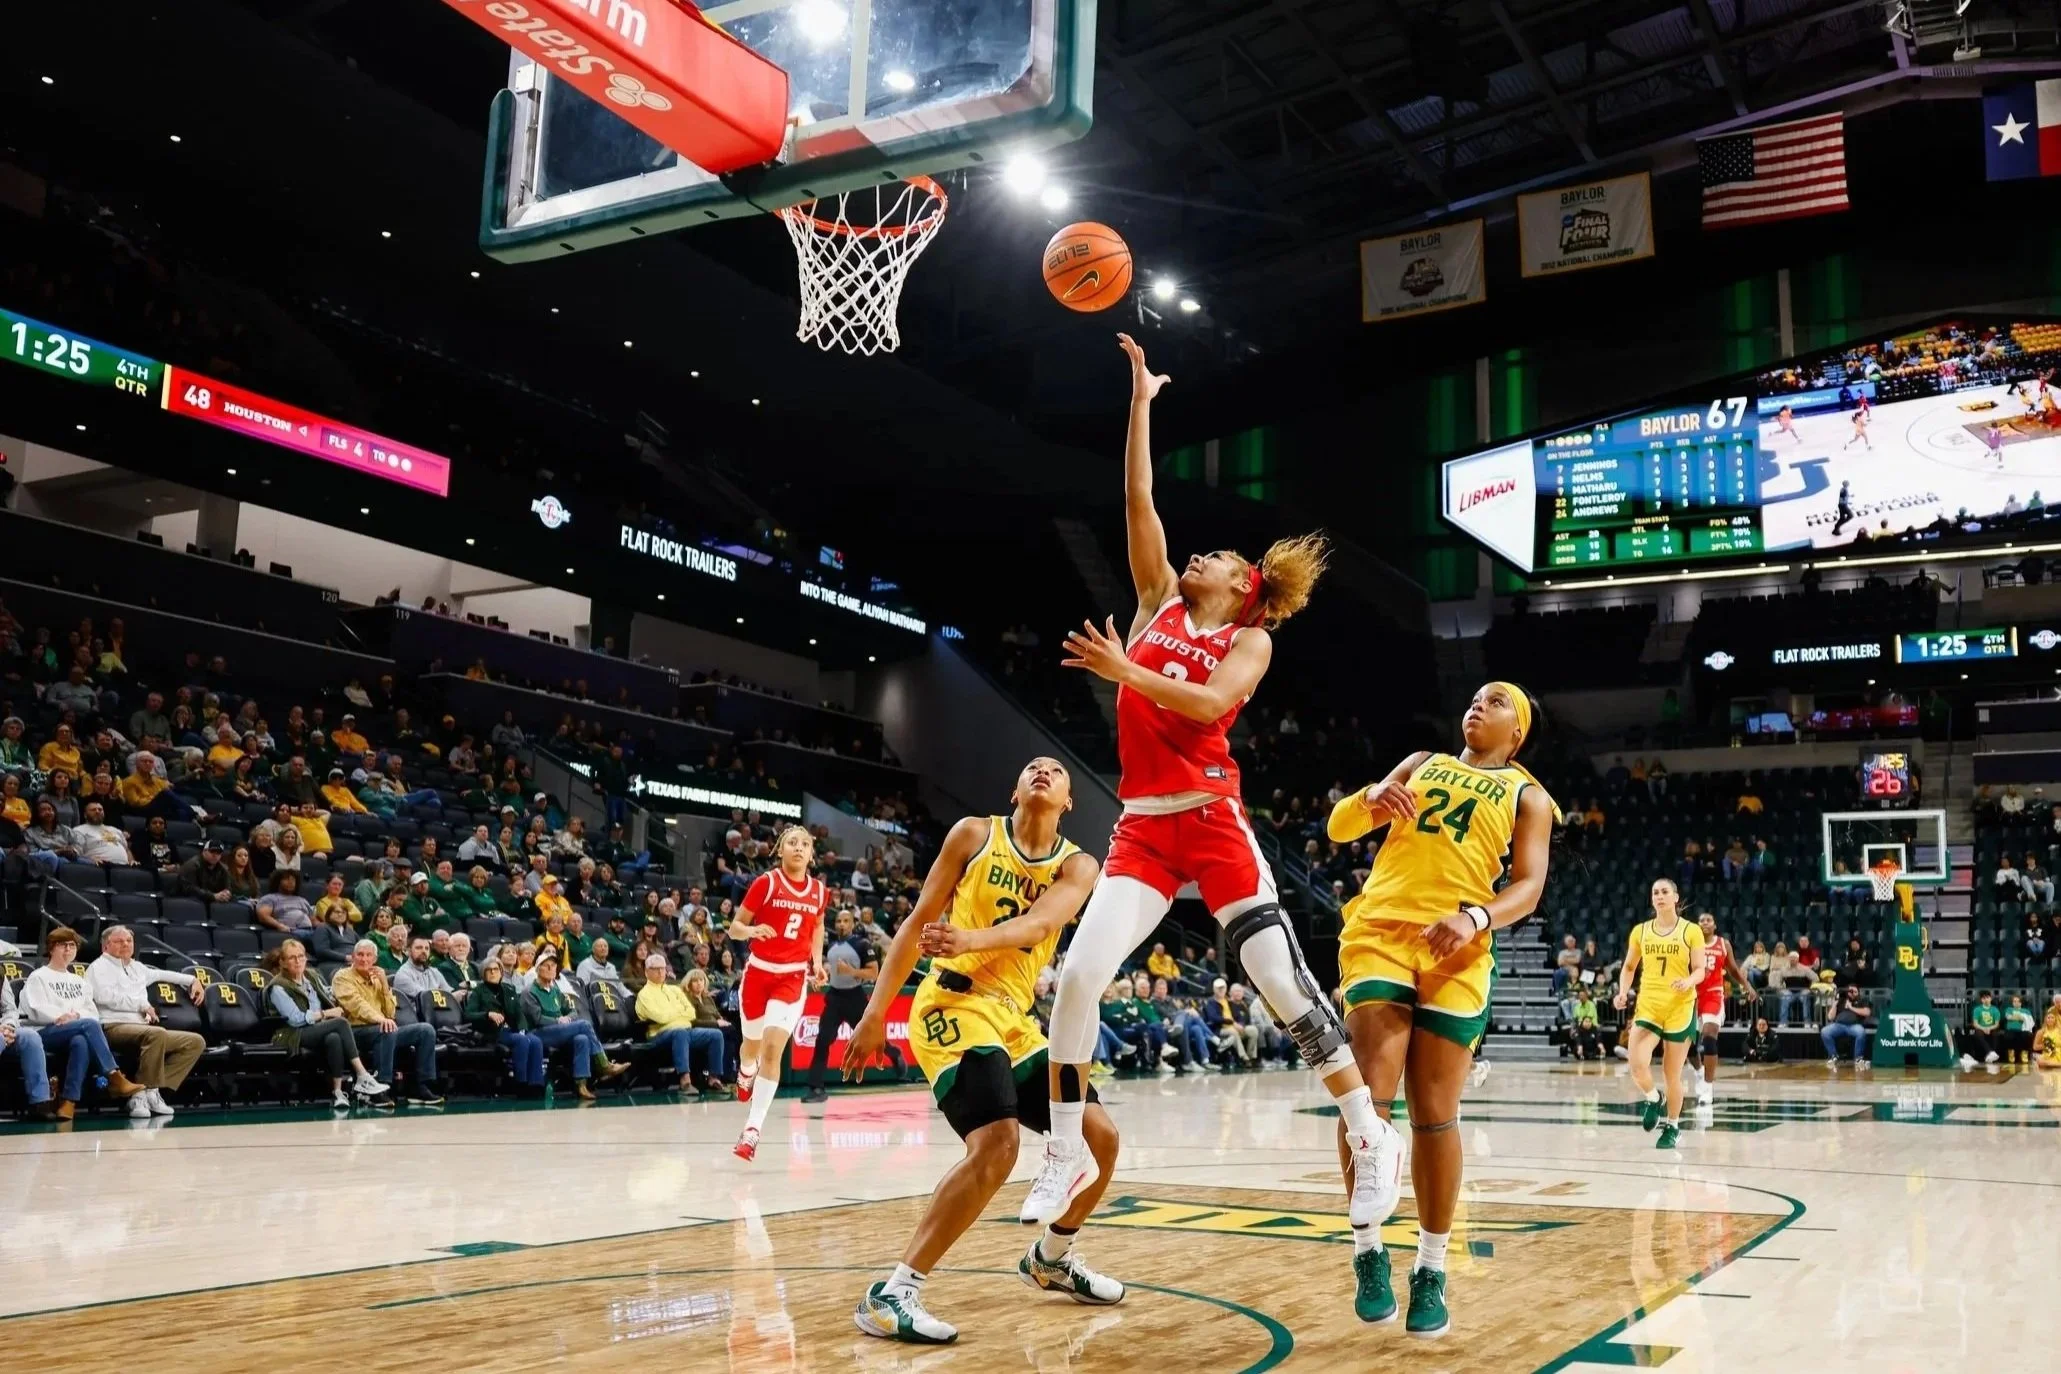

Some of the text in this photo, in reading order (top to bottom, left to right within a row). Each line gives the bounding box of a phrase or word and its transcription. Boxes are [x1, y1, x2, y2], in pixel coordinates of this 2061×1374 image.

[486, 2, 614, 75] State
[1561, 186, 1605, 204] BAYLOR
[1574, 216, 1608, 228] FINAL
[1400, 232, 1441, 251] BAYLOR
[1562, 225, 1608, 246] FOUR
[11, 321, 91, 375] 1:25
[116, 358, 149, 380] 4TH
[115, 376, 148, 397] QTR
[184, 389, 291, 432] 48 HOUSTON
[1707, 396, 1748, 429] 67
[1641, 412, 1700, 437] BAYLOR
[328, 434, 348, 451] FLS
[1703, 435, 1717, 443] AST
[372, 448, 387, 463] TO
[1572, 459, 1618, 472] JENNINGS
[1459, 478, 1517, 513] LIBMAN
[1572, 482, 1618, 494] MATHARU
[1572, 492, 1627, 506] FONTLEROY
[1572, 504, 1619, 517] ANDREWS
[1555, 532, 1570, 541] AST
[621, 525, 737, 582] FLAT ROCK TRAILERS
[321, 591, 338, 604] 120
[800, 580, 821, 599] INTO
[821, 587, 838, 606] THE
[837, 593, 862, 615] GAME,
[862, 602, 889, 624] ALIYAH
[395, 608, 411, 621] 119
[1917, 634, 1968, 658] 1:25
[1982, 634, 2006, 645] 4TH
[1144, 630, 1220, 671] HOUSTO
[1773, 643, 1881, 664] FLAT ROCK TRAILERS
[1420, 768, 1506, 806] BAYLOR
[1870, 769, 1902, 794] 26
[647, 781, 802, 818] TEXAS FARM BUREAU INSURANCE
[1416, 787, 1478, 844] 24
[772, 898, 819, 916] HOUSTON
[784, 912, 803, 940] 2
[1645, 943, 1680, 955] BAYLOR
[1656, 956, 1667, 976] 7
[922, 1007, 961, 1047] BU
[1880, 1038, 1944, 1048] Your Bank for Life
